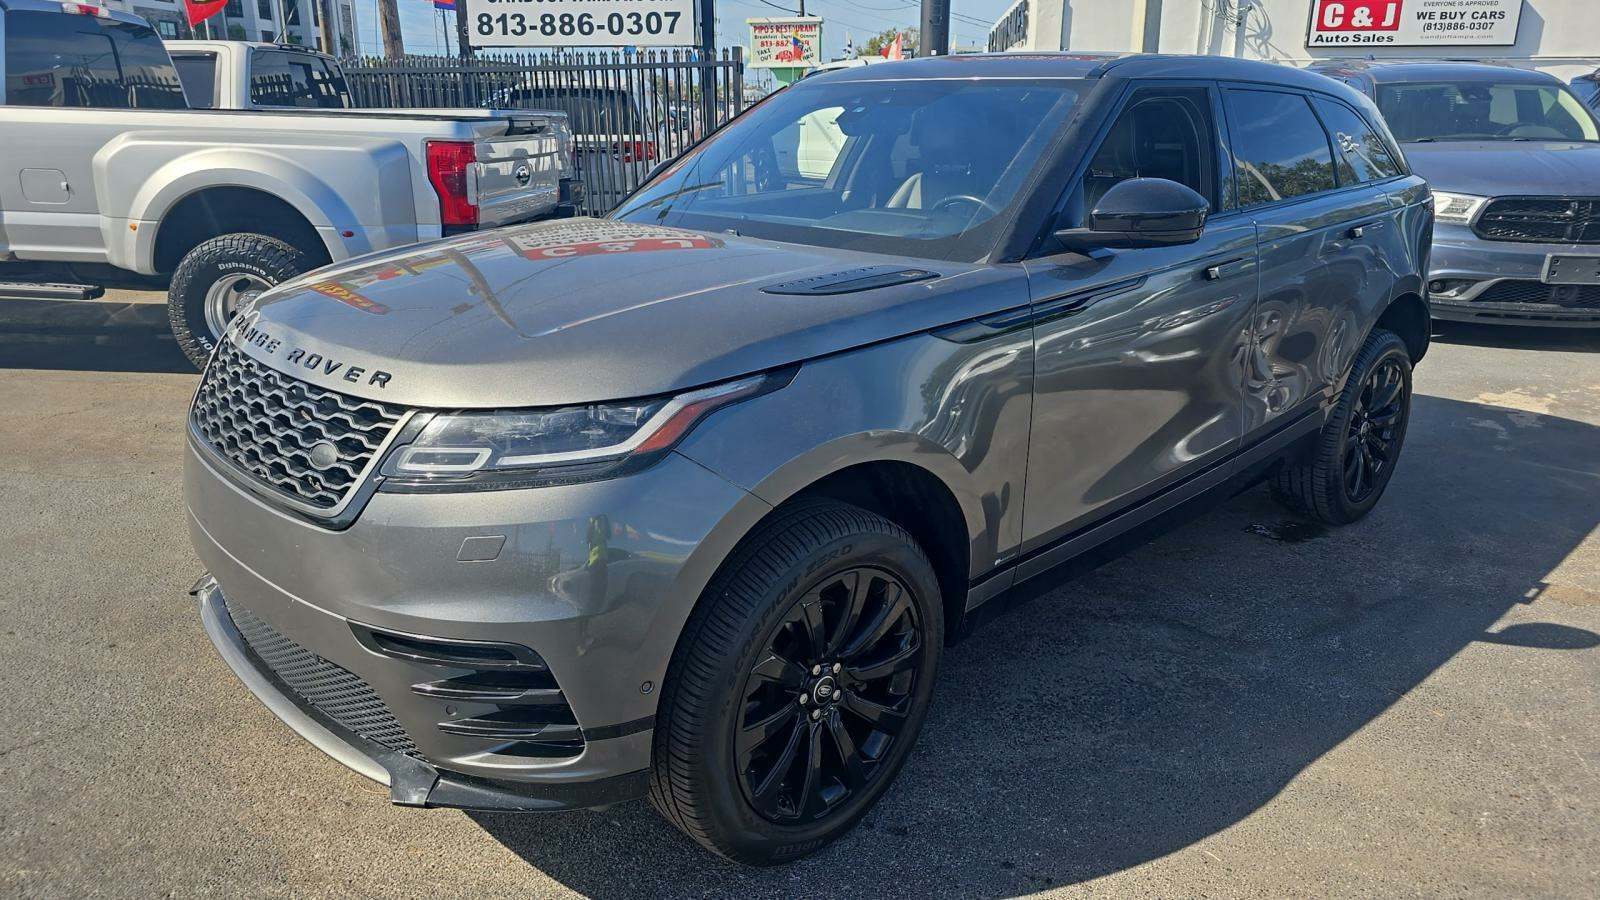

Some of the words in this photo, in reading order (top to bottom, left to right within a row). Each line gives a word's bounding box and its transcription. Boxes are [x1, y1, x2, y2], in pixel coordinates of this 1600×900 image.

[1323, 3, 1344, 28] C
[1350, 4, 1374, 27] &
[1381, 3, 1397, 27] J
[1416, 11, 1436, 20] WE
[1440, 11, 1467, 20] BUY
[1471, 11, 1506, 20] CARS
[477, 11, 682, 37] 813-886-0307
[775, 24, 817, 33] RESTURANT
[1423, 22, 1495, 32] (813)886-0307
[1314, 34, 1350, 44] Auto
[1352, 33, 1394, 43] Sales
[234, 314, 281, 354] RANGE
[287, 347, 392, 389] ROVER
